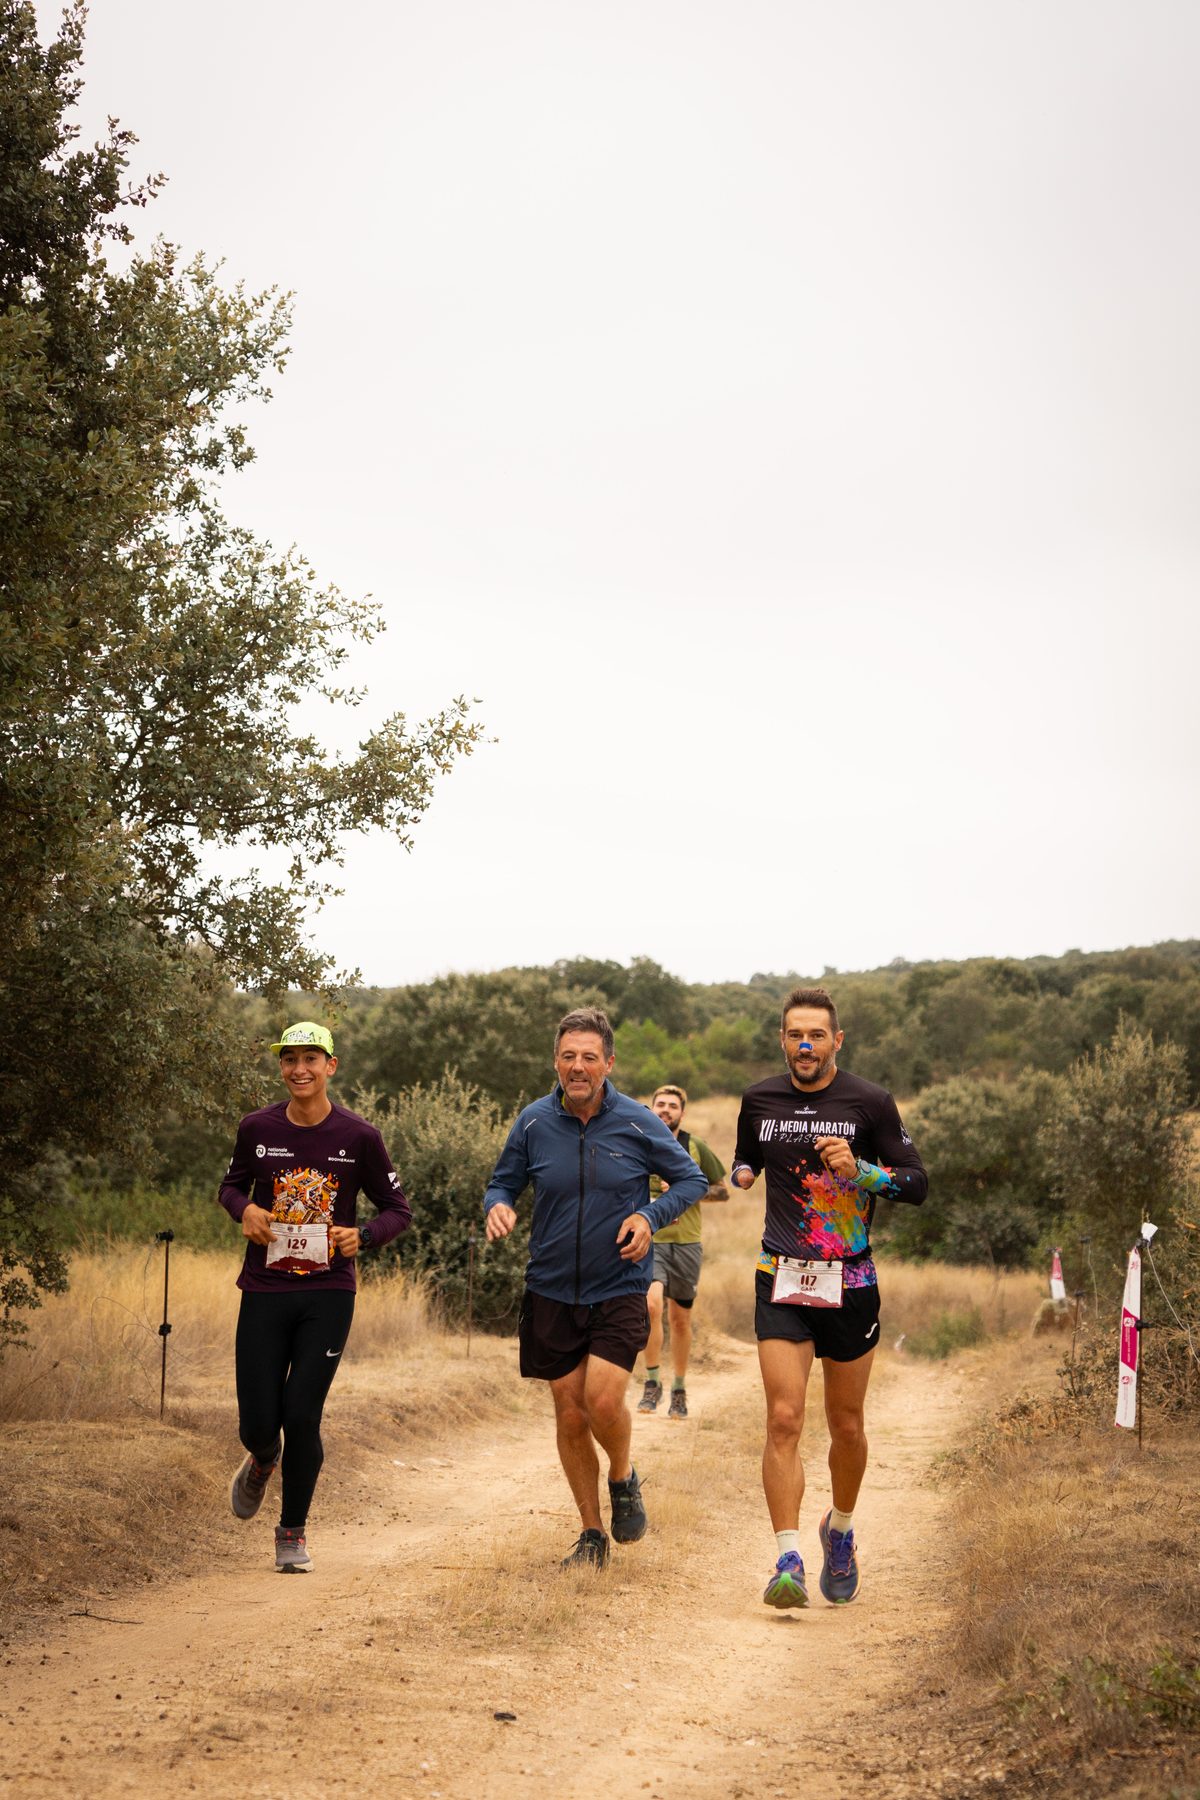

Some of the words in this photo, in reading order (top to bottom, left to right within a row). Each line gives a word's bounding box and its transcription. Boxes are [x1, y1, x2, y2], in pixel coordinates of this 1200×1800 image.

[780, 1120, 808, 1133] MEDIA
[811, 1121, 856, 1136] MARATÓN
[288, 1238, 307, 1249] 129
[800, 1274, 817, 1287] 117
